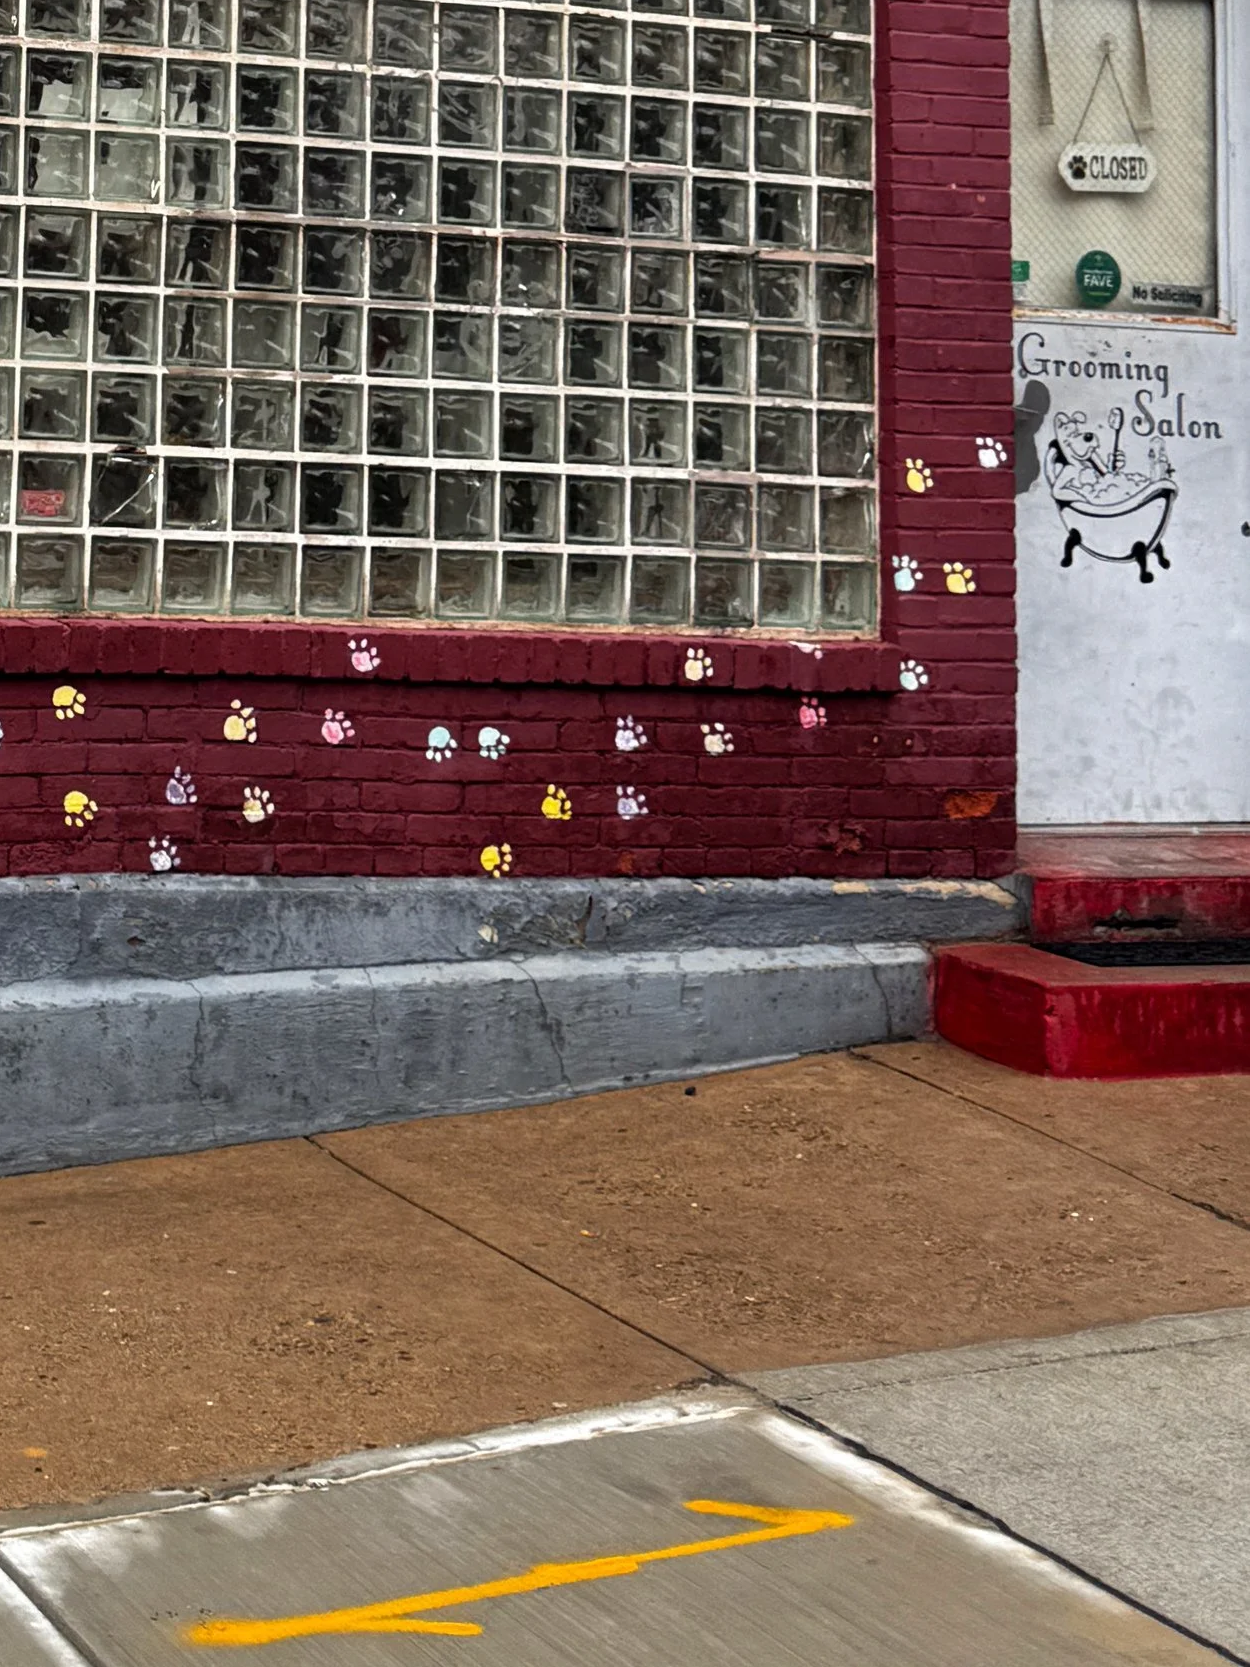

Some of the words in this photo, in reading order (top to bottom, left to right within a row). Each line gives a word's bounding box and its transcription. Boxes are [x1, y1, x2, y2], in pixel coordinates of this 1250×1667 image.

[1089, 155, 1148, 180] CLOSED
[1083, 273, 1114, 288] FAVE
[1132, 285, 1148, 300] No
[1017, 332, 1169, 399] Grooming
[1132, 389, 1223, 440] Salon
